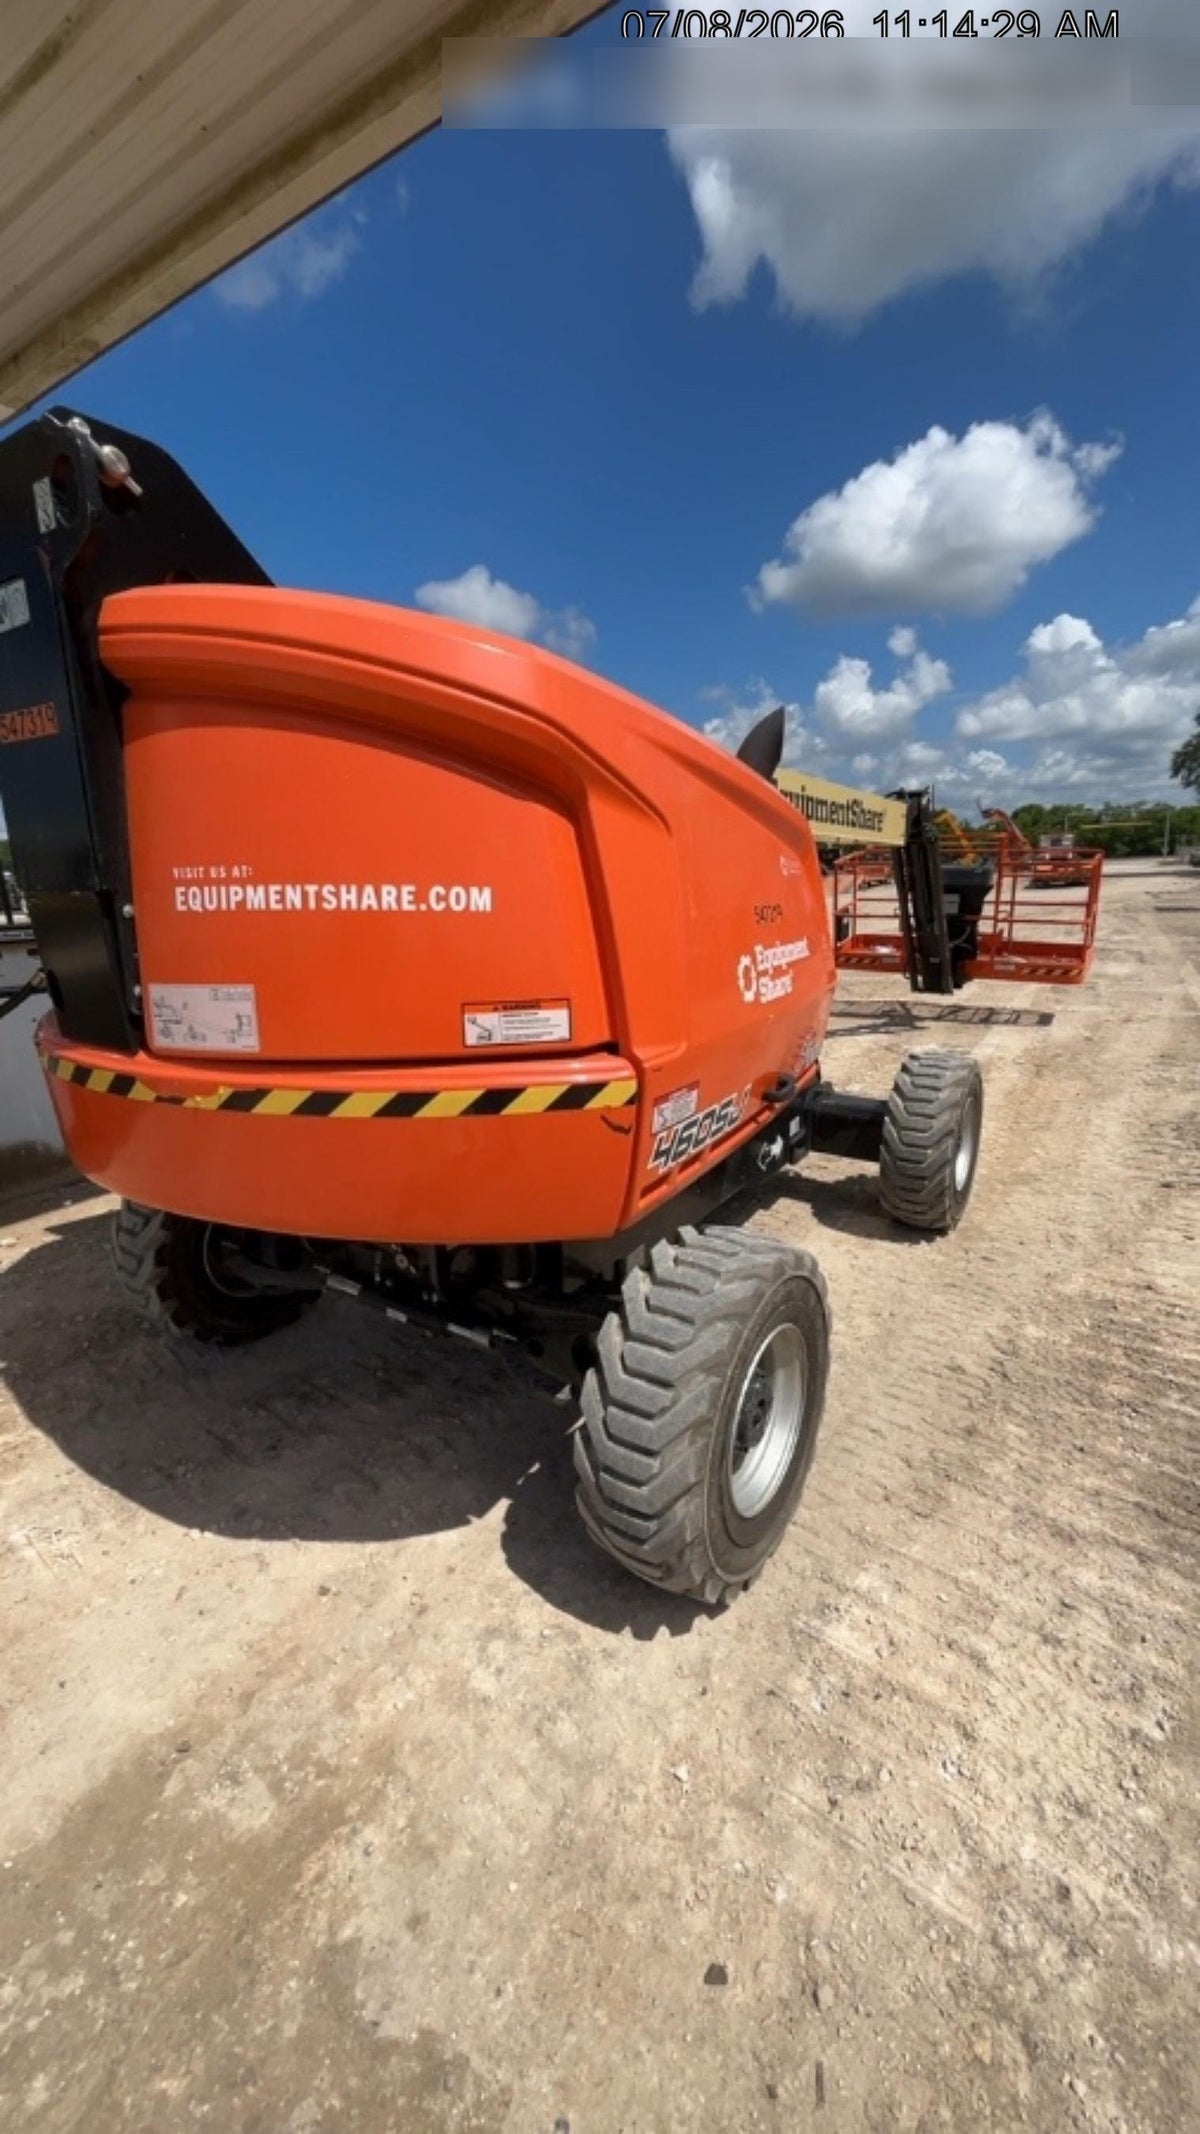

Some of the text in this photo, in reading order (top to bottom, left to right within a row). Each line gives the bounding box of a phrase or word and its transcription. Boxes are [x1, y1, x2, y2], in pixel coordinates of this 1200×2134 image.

[173, 864, 254, 880] VISIT US AT:
[174, 884, 492, 913] EQUIPMENTSHARE.COM
